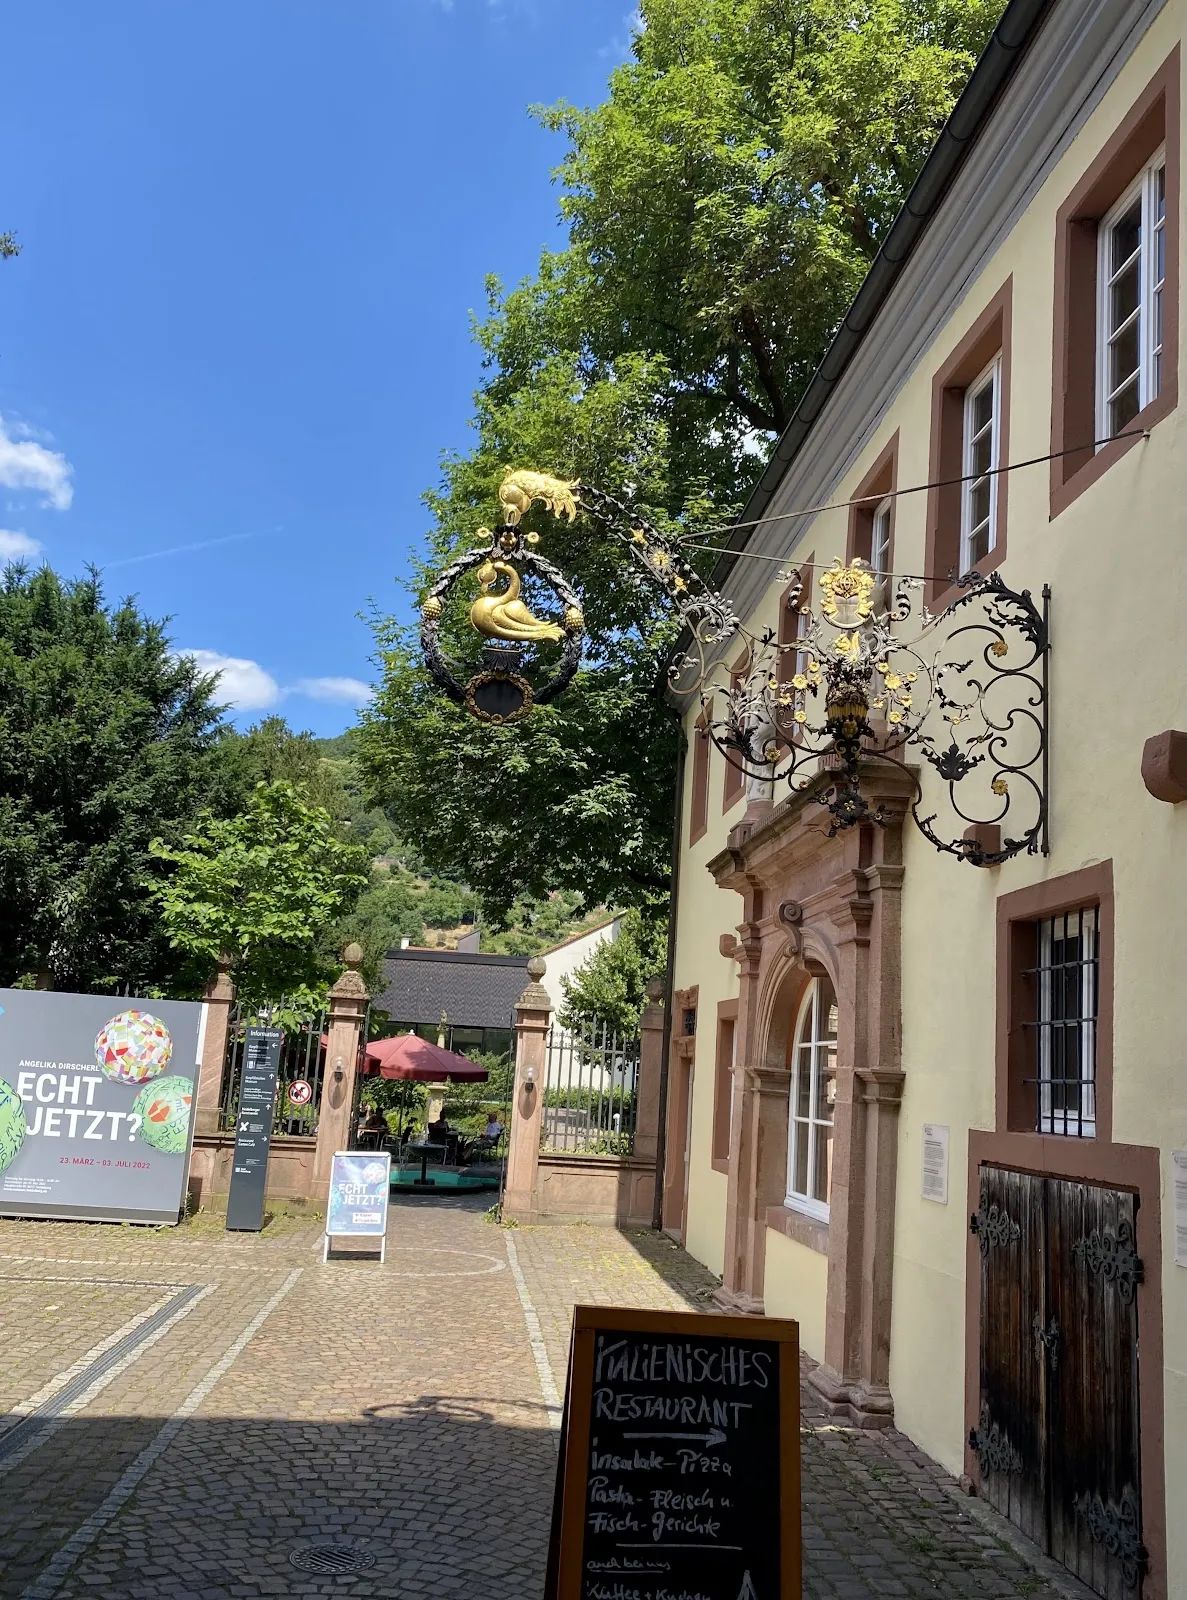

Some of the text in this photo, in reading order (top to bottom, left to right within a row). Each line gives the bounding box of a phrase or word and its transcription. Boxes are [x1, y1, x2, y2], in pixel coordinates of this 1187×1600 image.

[250, 1030, 280, 1038] Information
[19, 1060, 100, 1072] ANGELIKA DIRSCHERL
[17, 1071, 103, 1106] ECHT
[26, 1106, 143, 1142] JETZT?
[72, 1157, 95, 1165] MÄRZ
[132, 1161, 151, 1169] 2022
[338, 1183, 368, 1194] ECHT
[342, 1194, 382, 1206] JETZT?
[593, 1388, 752, 1428] RESTAURANT
[650, 1488, 714, 1509] Fleisch
